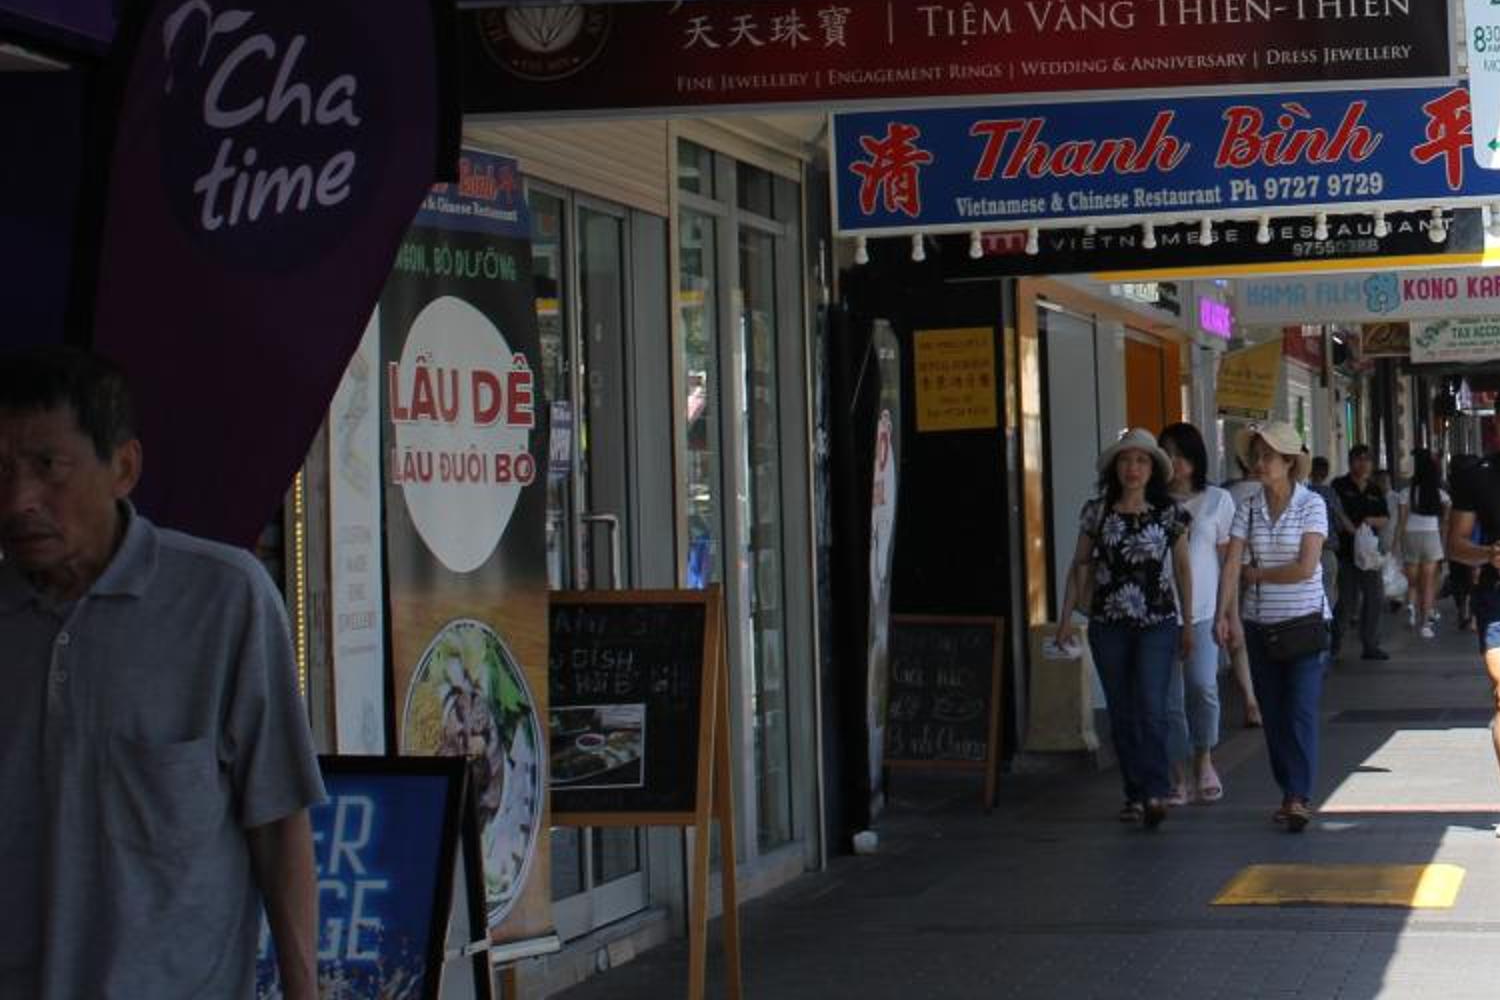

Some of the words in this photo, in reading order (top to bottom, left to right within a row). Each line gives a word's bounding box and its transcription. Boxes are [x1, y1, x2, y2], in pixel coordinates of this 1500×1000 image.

[683, 5, 853, 50] 天天珠寶
[202, 34, 362, 130] Cha
[676, 77, 712, 91] FINE
[720, 72, 808, 90] JEWELLERY
[828, 66, 942, 85] ENGAGEMENT
[949, 62, 1002, 79] RINGS
[1022, 59, 1107, 76] WEDDING
[1111, 56, 1128, 72] &
[1131, 51, 1247, 72] ANNIVERSARY
[1266, 49, 1317, 66] DRESS
[1323, 44, 1412, 63] JEWELLERY
[968, 110, 1191, 181] Thanh
[1215, 101, 1386, 166] Bình
[193, 145, 356, 231] time
[955, 192, 1047, 216] Vietnamese
[1050, 191, 1064, 213] &
[1067, 188, 1129, 211] Chinese
[1133, 184, 1222, 209] Restaurant
[1230, 178, 1259, 202] Ph
[1264, 174, 1321, 200] 9727
[1327, 171, 1384, 197] 9729
[1402, 277, 1459, 301] KONO
[1451, 325, 1471, 338] TAX
